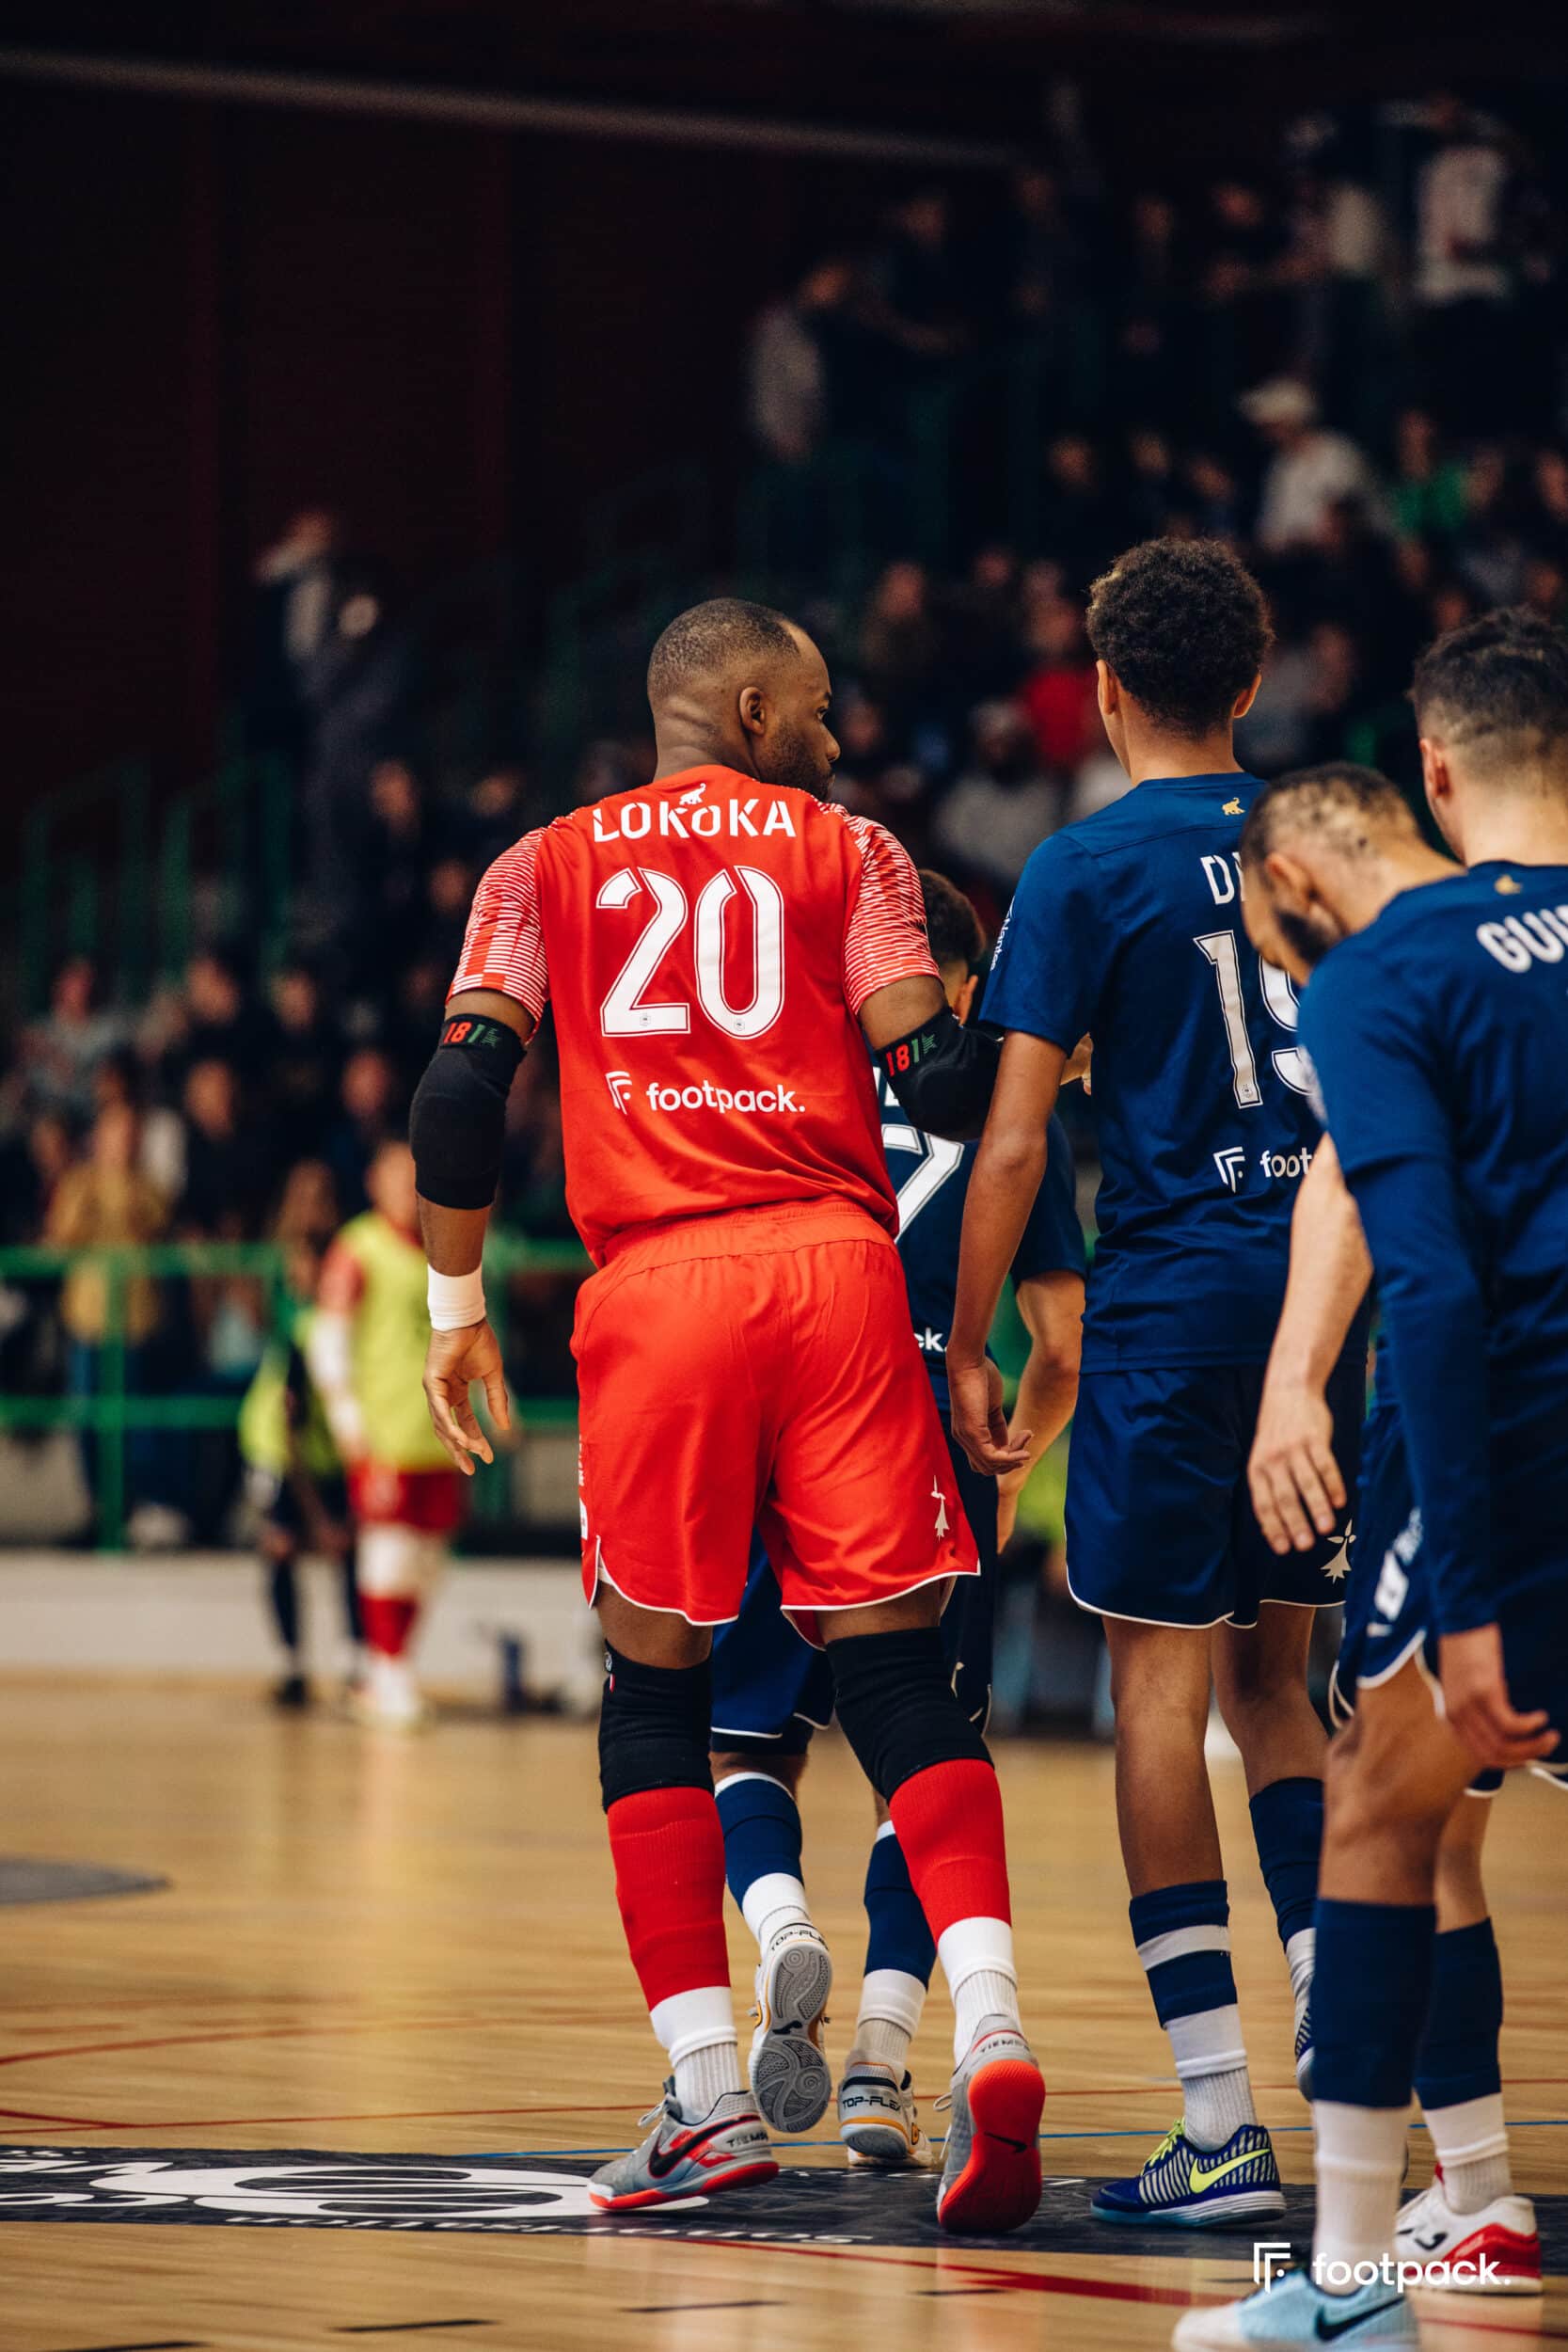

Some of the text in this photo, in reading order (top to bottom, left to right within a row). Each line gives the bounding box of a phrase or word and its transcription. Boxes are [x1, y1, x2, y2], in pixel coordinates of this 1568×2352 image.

[593, 799, 797, 843] LOKOKA
[595, 865, 785, 1040] 20
[645, 1079, 806, 1114] footpack.
